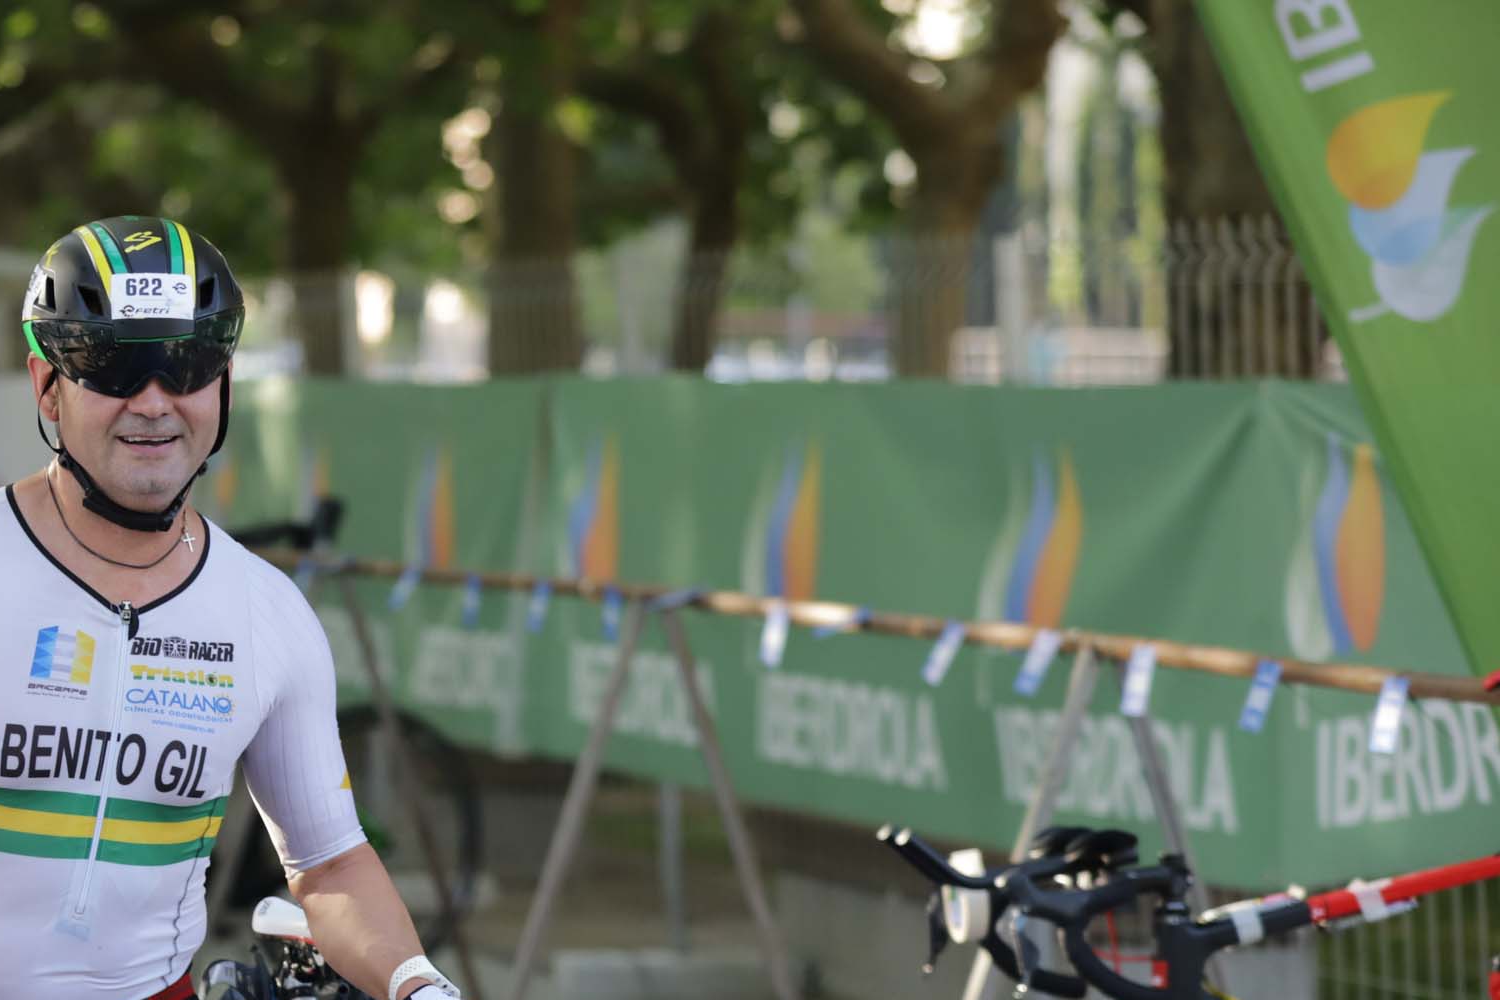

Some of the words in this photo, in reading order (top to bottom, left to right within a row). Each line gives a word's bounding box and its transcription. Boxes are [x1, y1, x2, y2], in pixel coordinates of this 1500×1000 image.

[126, 278, 162, 296] 622
[189, 641, 234, 662] RACER
[126, 688, 232, 714] CATALANO
[0, 724, 146, 785] BENITO
[155, 740, 208, 799] GIL
